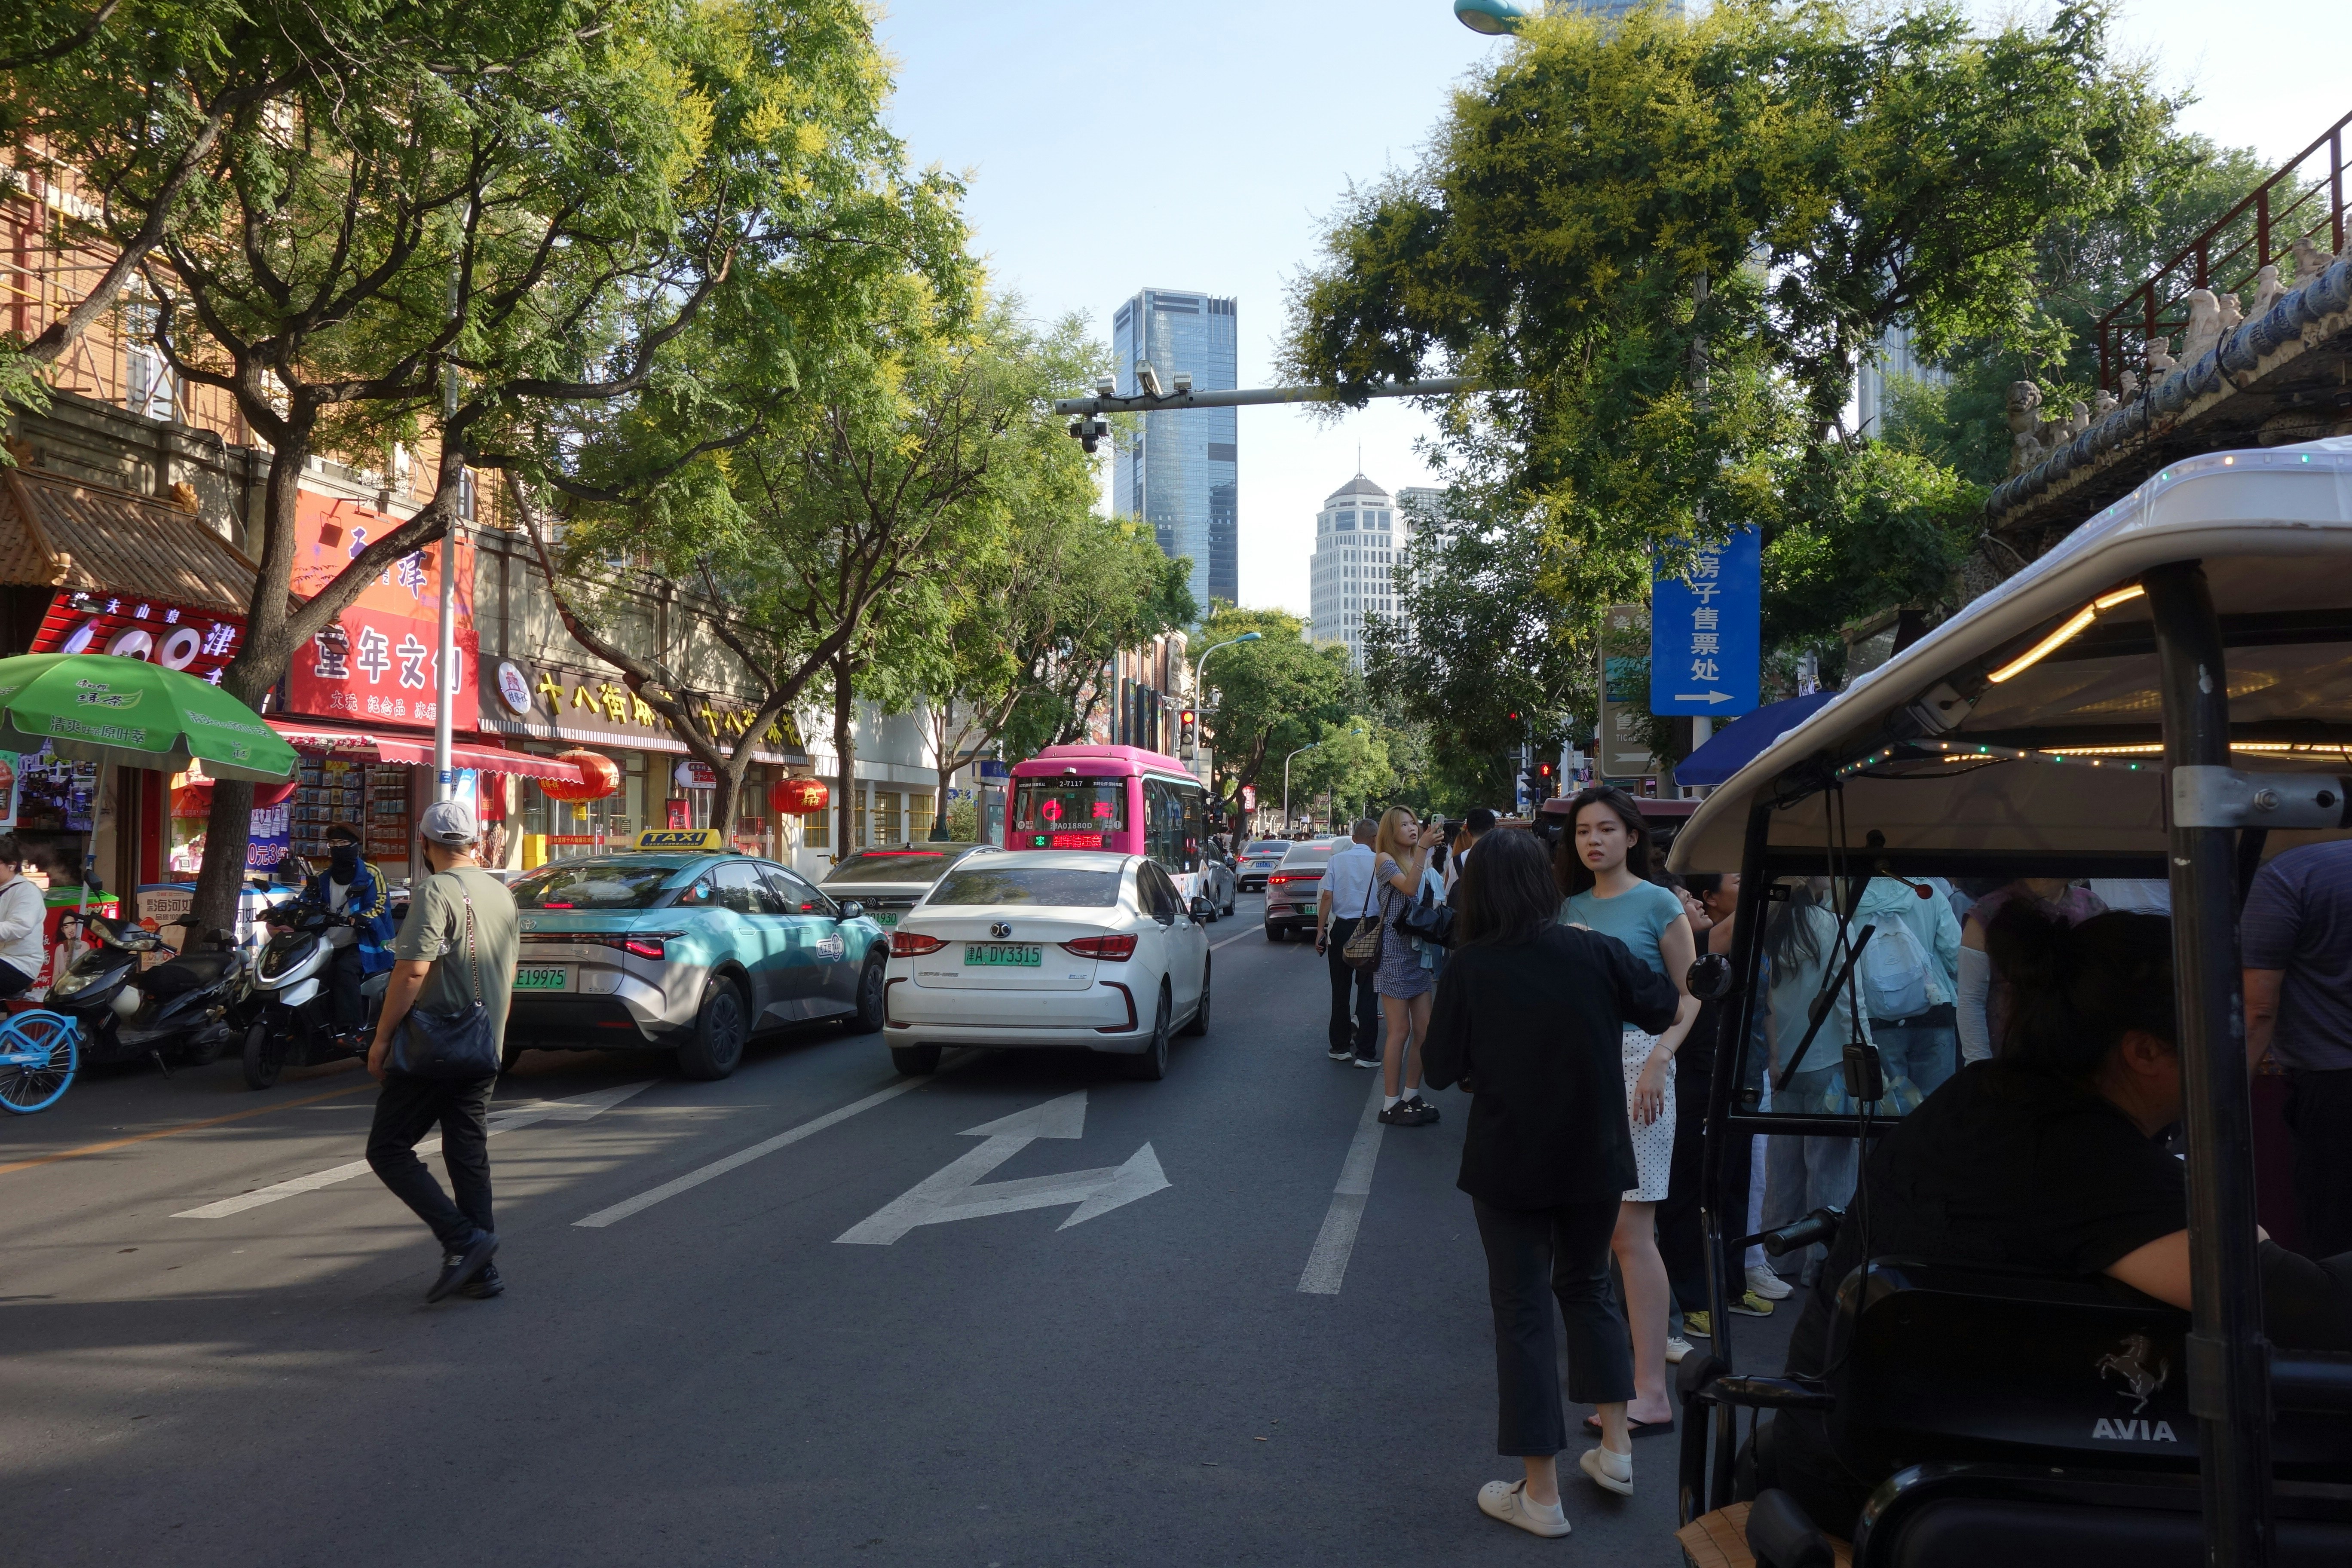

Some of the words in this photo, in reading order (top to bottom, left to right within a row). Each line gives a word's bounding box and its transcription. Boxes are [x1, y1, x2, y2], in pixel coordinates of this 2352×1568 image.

[69, 592, 180, 624] 夫山泉
[330, 690, 358, 711] 文玩
[367, 695, 405, 717] 纪念品
[49, 715, 147, 744] 清爽好茶原叶萃
[650, 833, 703, 842] TAXI
[989, 946, 1040, 963] DY3315
[516, 969, 564, 985] E19975
[2092, 1418, 2177, 1442] AVIA
